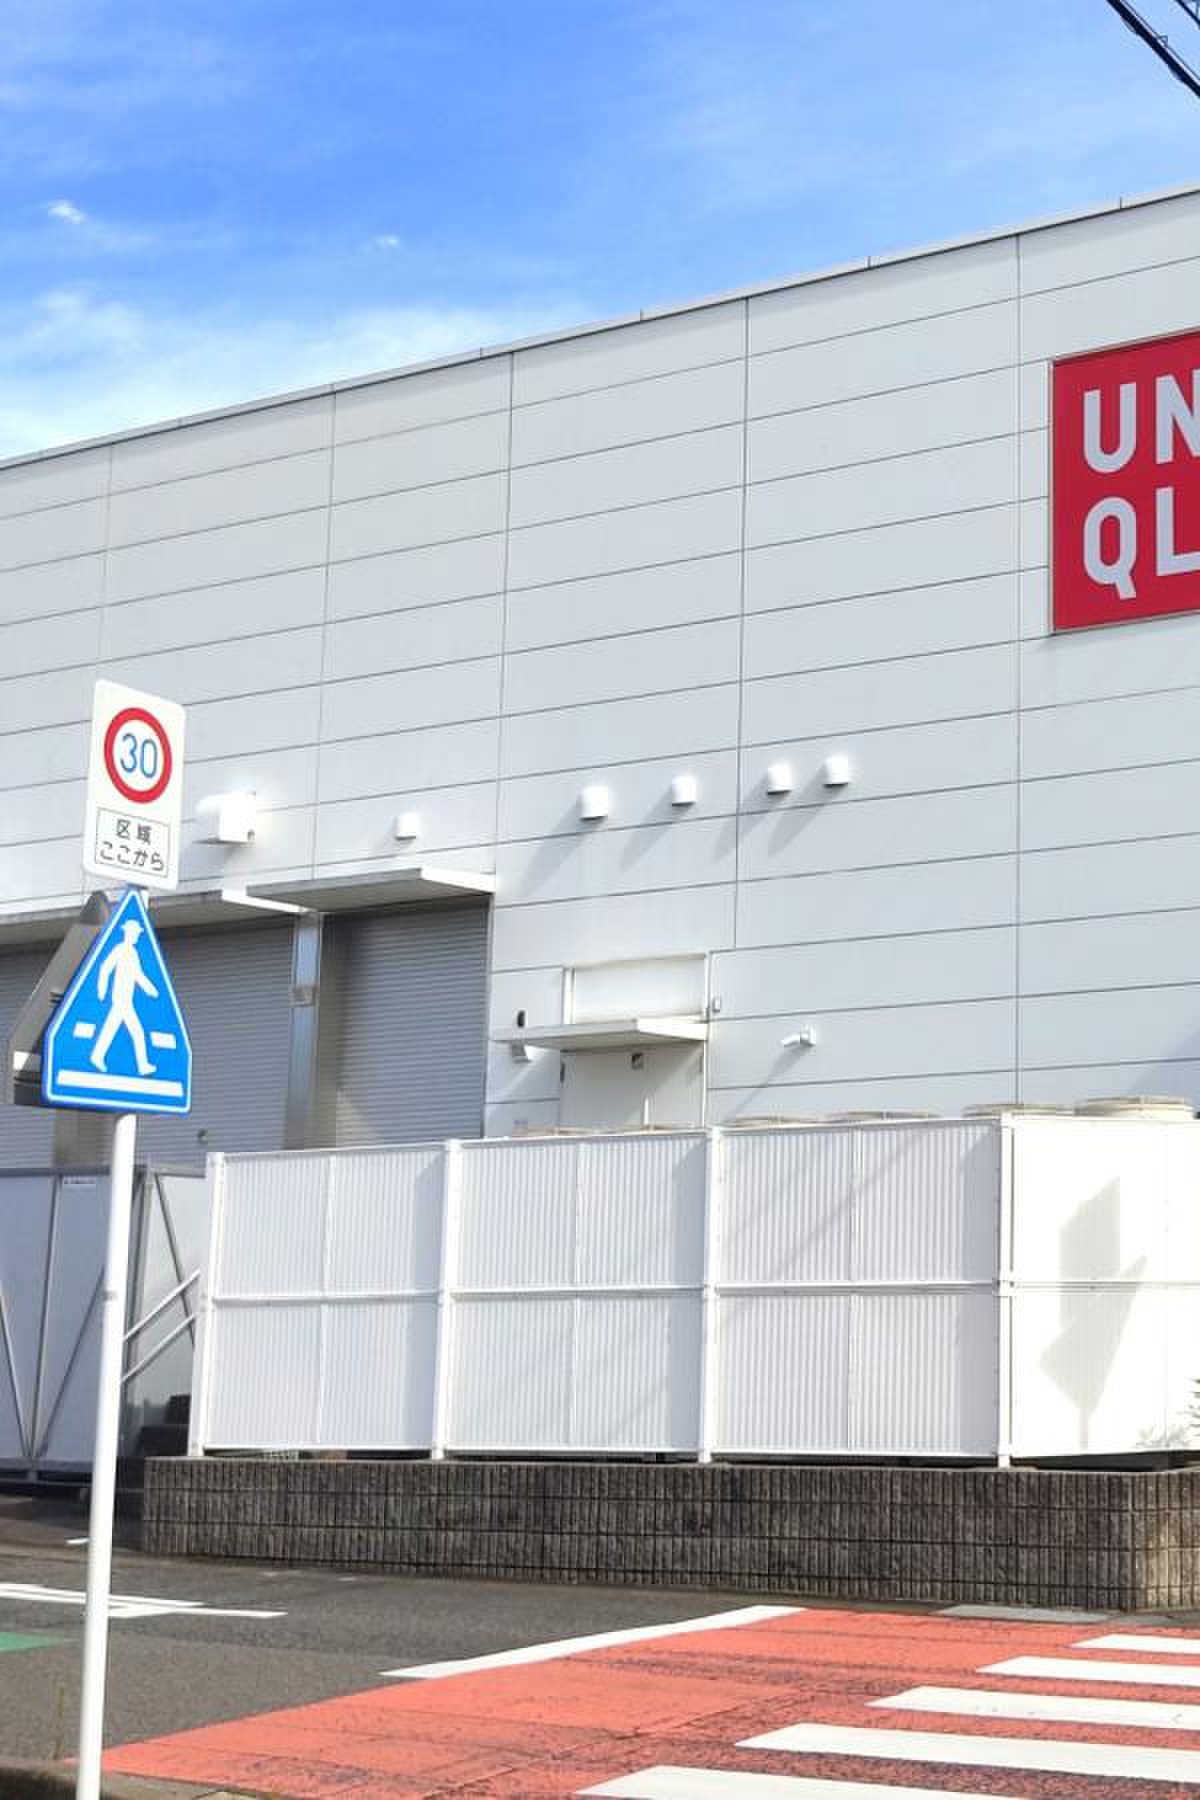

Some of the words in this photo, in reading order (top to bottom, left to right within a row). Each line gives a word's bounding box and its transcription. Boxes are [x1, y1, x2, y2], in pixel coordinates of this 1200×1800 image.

[120, 732, 158, 779] 30
[116, 818, 151, 845] 区域
[100, 841, 165, 871] ここから
